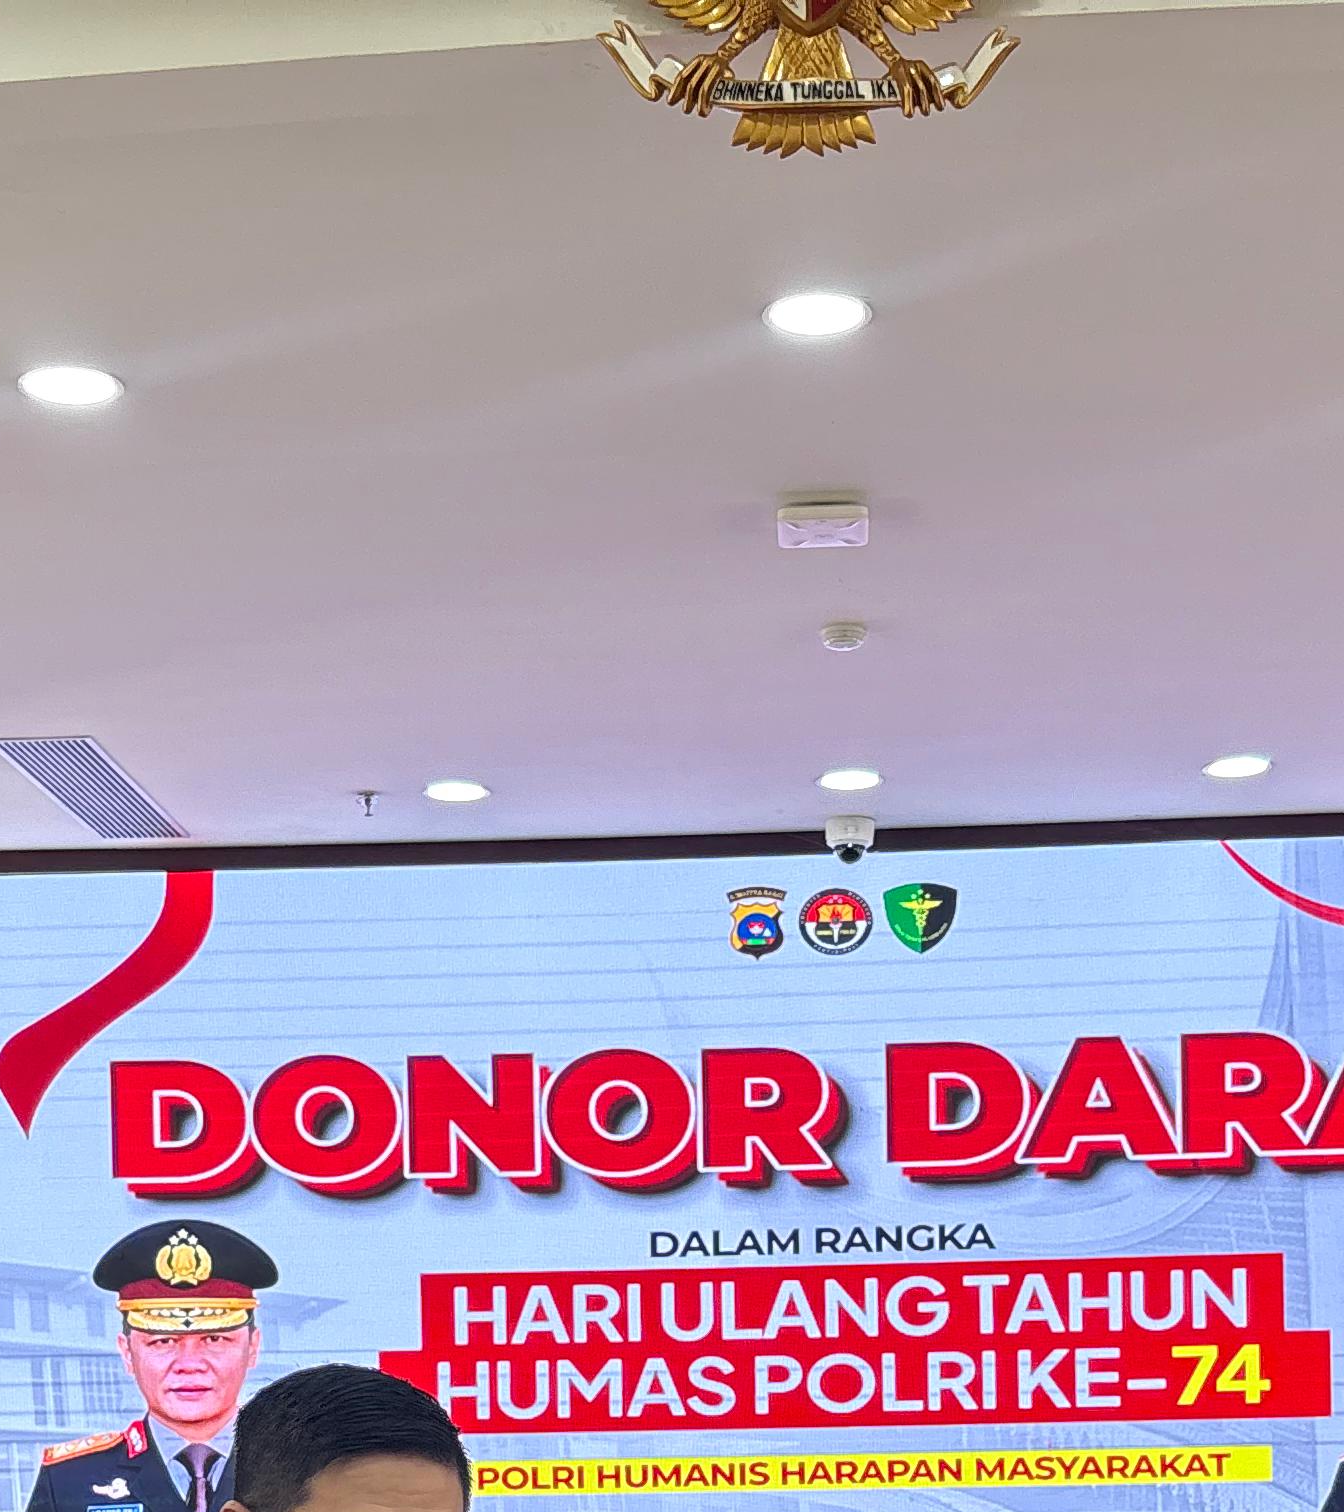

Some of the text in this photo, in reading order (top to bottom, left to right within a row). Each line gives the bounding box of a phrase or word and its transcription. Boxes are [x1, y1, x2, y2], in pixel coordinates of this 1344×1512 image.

[713, 79, 898, 102] BHINNEKA TUNGGAL IKA
[109, 1048, 848, 1198] DONOR
[649, 1223, 996, 1258] DALAM RANGKA
[453, 1267, 1248, 1346] HARI ULANG TAHUN
[436, 1355, 736, 1420] HUMAS
[754, 1348, 997, 1415] POLRI
[478, 1452, 1231, 1490] POLRI HUMANIS HARAPAN MASYARAKAT
